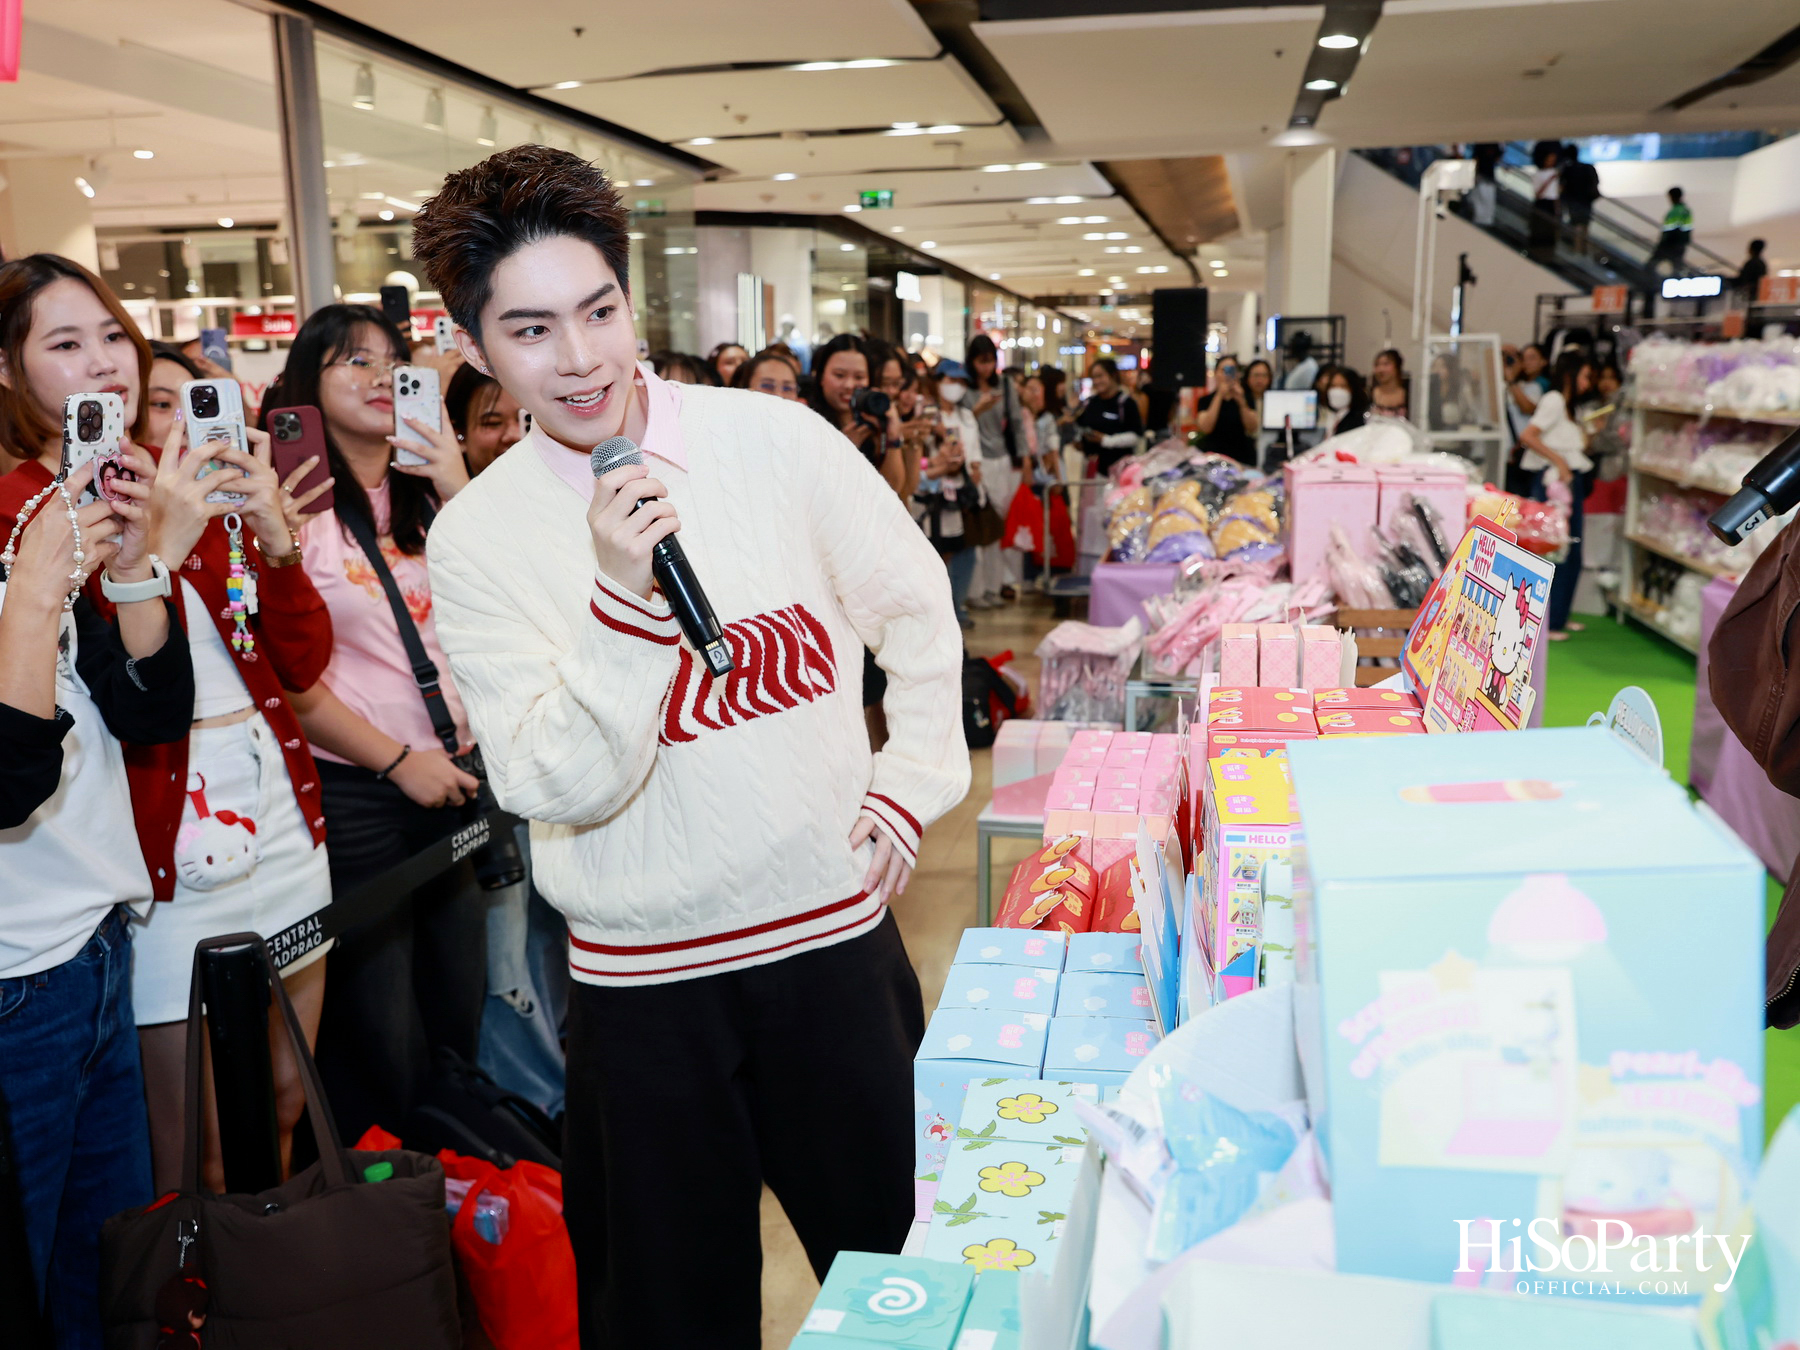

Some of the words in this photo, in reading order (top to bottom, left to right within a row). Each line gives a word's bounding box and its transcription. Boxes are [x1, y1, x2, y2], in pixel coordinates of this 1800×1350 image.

[1744, 516, 1760, 531] 3
[1477, 533, 1497, 558] HELLO
[1473, 554, 1492, 579] KITTY
[714, 650, 725, 664] 2
[451, 818, 490, 849] CENTRAL
[1248, 834, 1287, 845] HELLO
[452, 831, 490, 862] LADPRAO
[273, 931, 322, 968] ADPRAO
